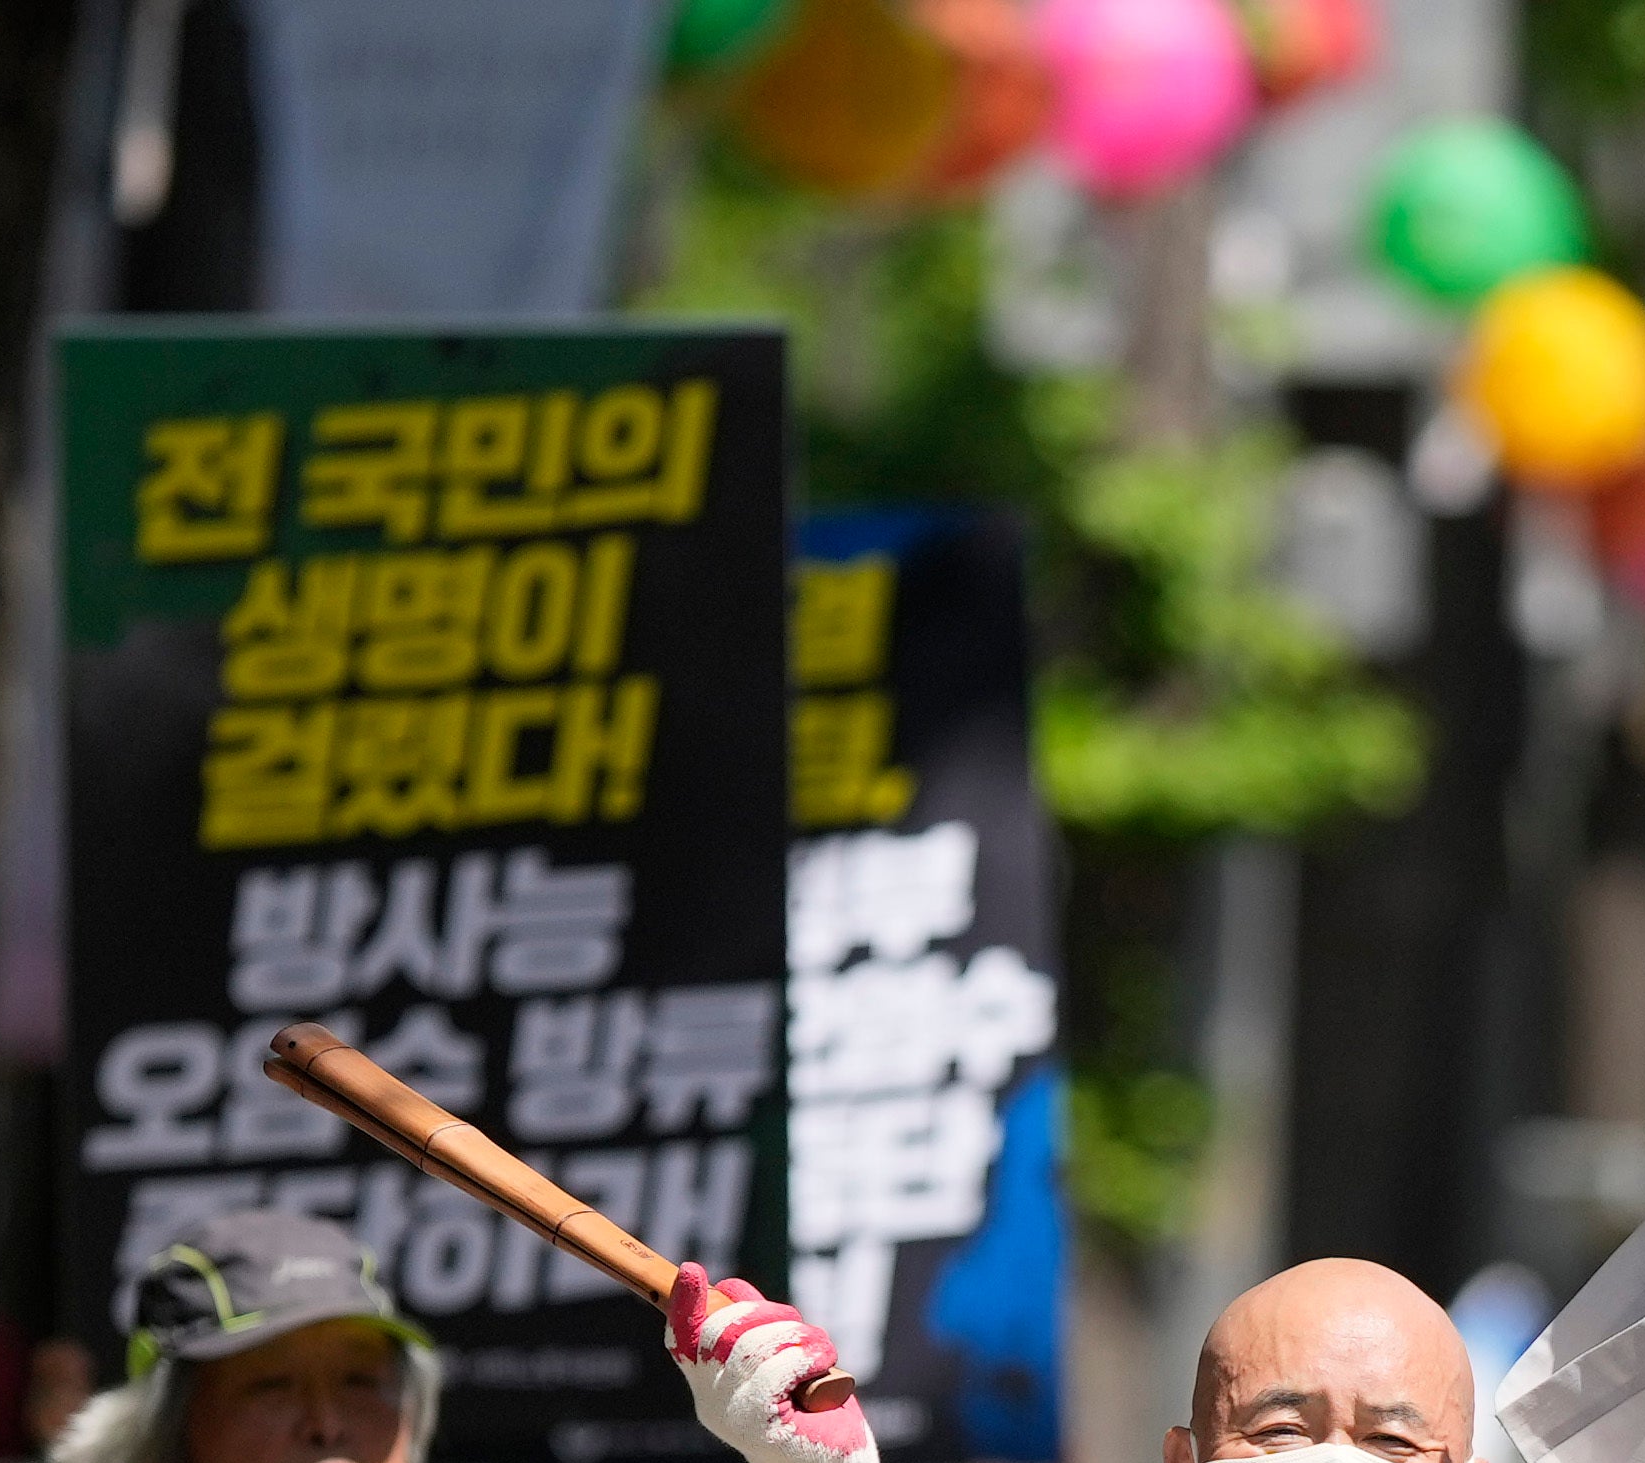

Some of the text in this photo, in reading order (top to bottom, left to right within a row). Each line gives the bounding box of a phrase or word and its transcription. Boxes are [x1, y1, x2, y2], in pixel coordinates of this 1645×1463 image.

[136, 380, 717, 563] 전 국민의
[221, 535, 636, 701] 생명이
[199, 676, 660, 850] 걸렸다!
[228, 851, 633, 1010] 방사능
[510, 980, 778, 1140] 방류
